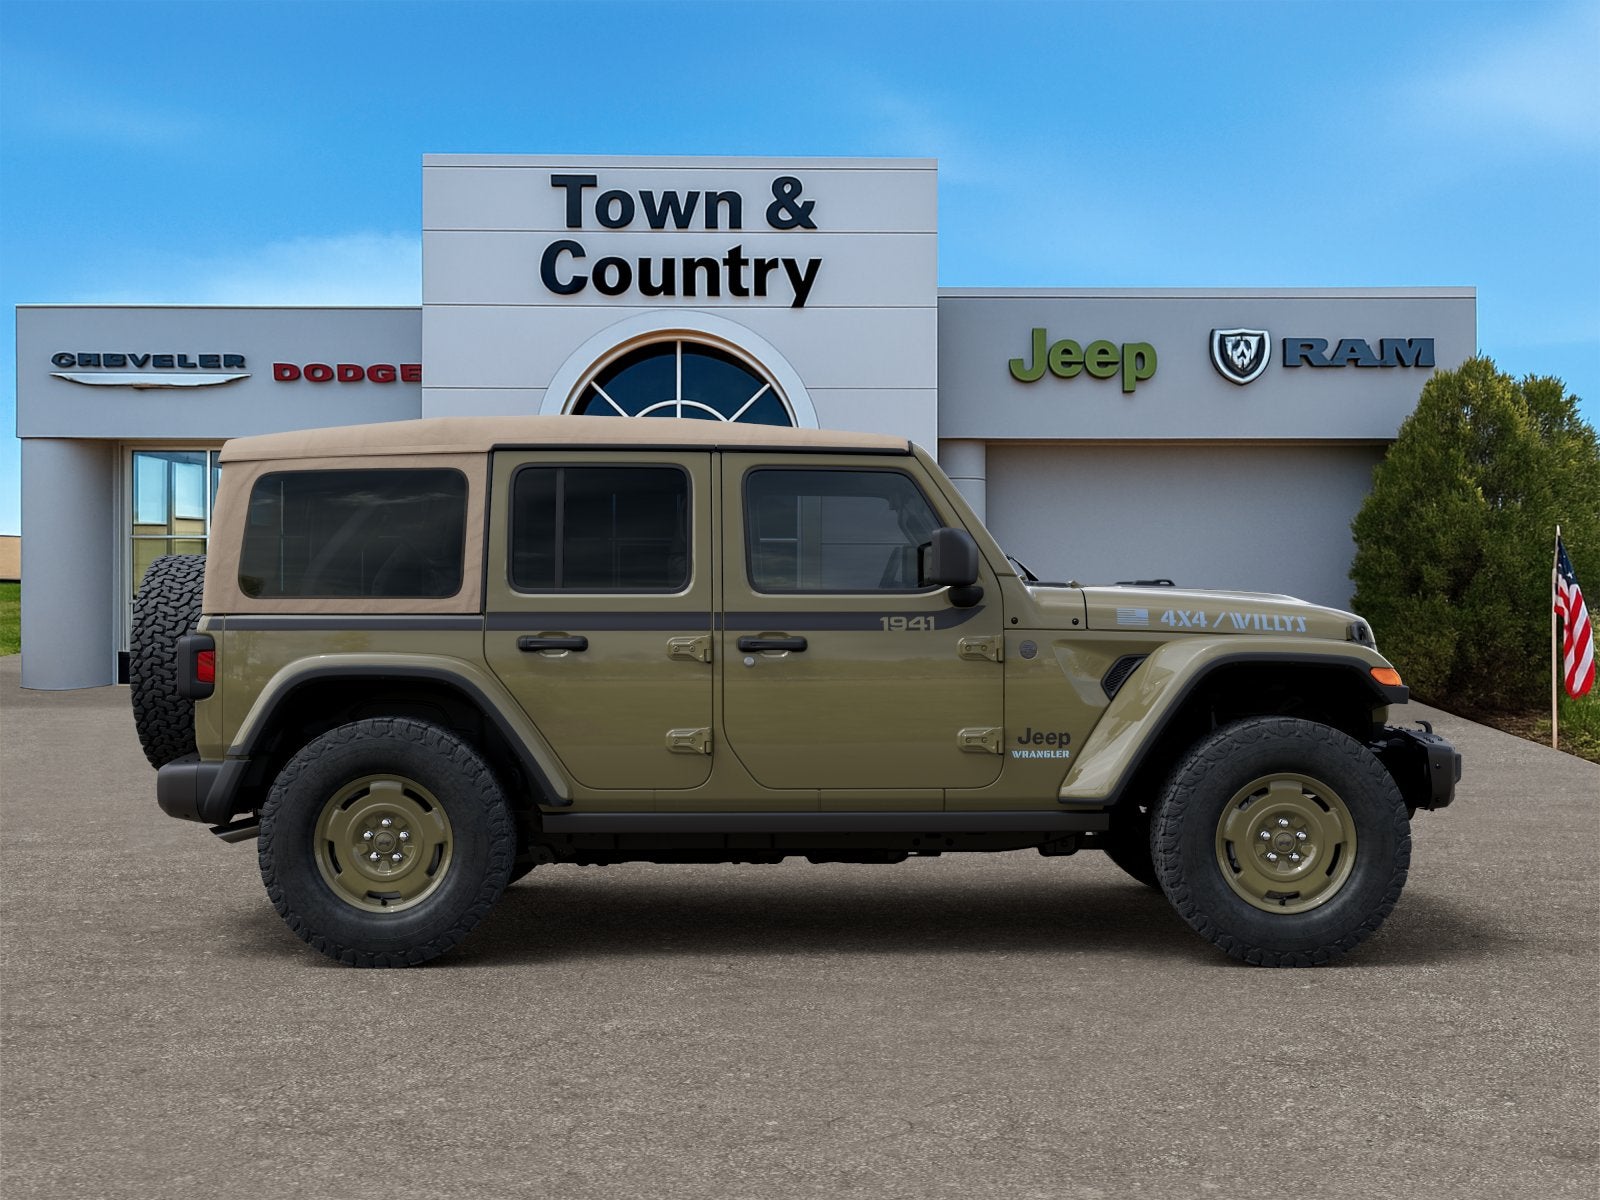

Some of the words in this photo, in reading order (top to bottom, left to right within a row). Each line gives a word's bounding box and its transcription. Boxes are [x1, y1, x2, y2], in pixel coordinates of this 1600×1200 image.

[550, 174, 742, 229] Town
[765, 176, 818, 230] &
[540, 239, 822, 308] Country
[1008, 328, 1157, 392] Jeep
[1282, 337, 1436, 368] RAM
[273, 363, 422, 383] DODGE
[879, 616, 935, 631] 1941
[1229, 612, 1307, 633] WILLYS
[1017, 728, 1071, 748] Jeep
[1011, 750, 1070, 759] WRANGLER
